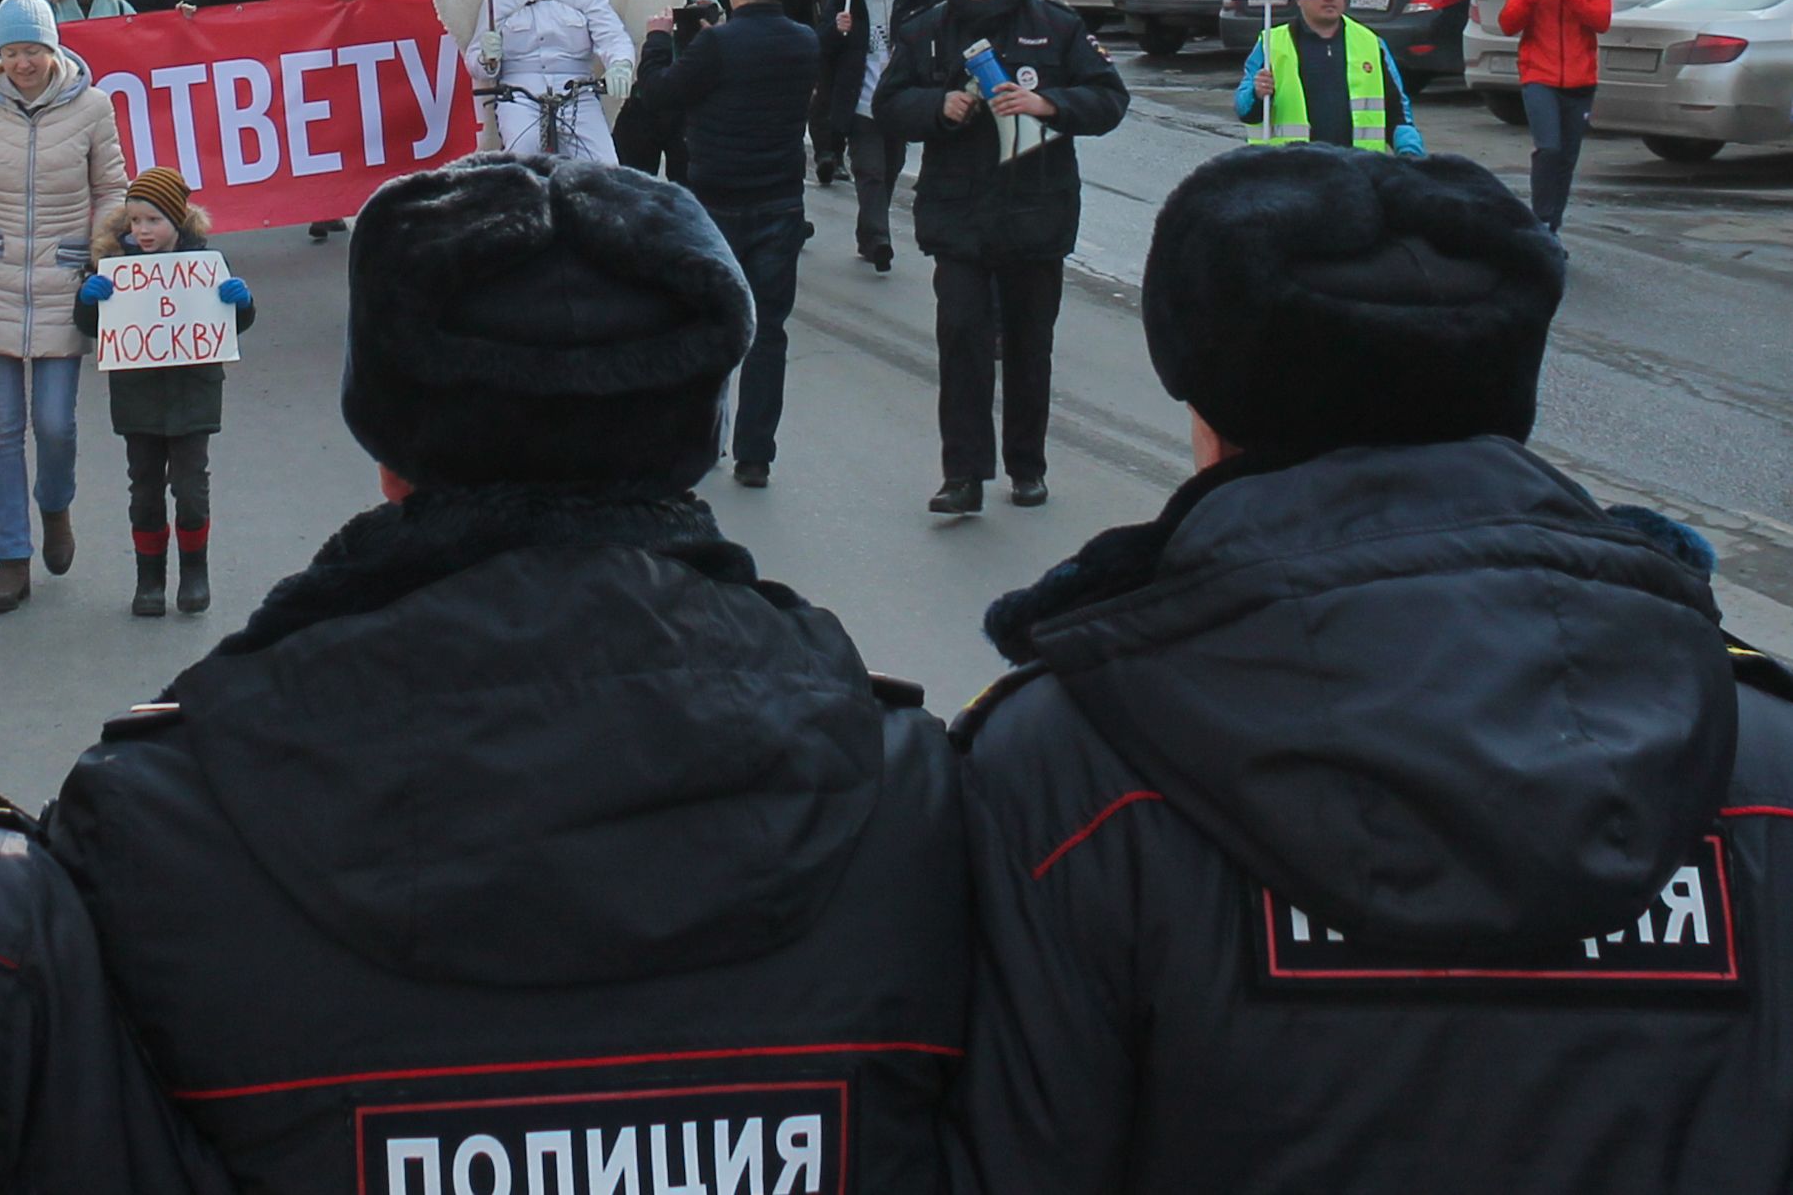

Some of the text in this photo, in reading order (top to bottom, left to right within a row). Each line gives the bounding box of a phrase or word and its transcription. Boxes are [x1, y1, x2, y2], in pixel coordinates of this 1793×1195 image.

[112, 260, 218, 292] СВАЛКУ
[160, 296, 176, 318] В
[98, 321, 226, 363] МОСКВУ
[386, 1114, 822, 1195] ПОЛИЦИЯ
